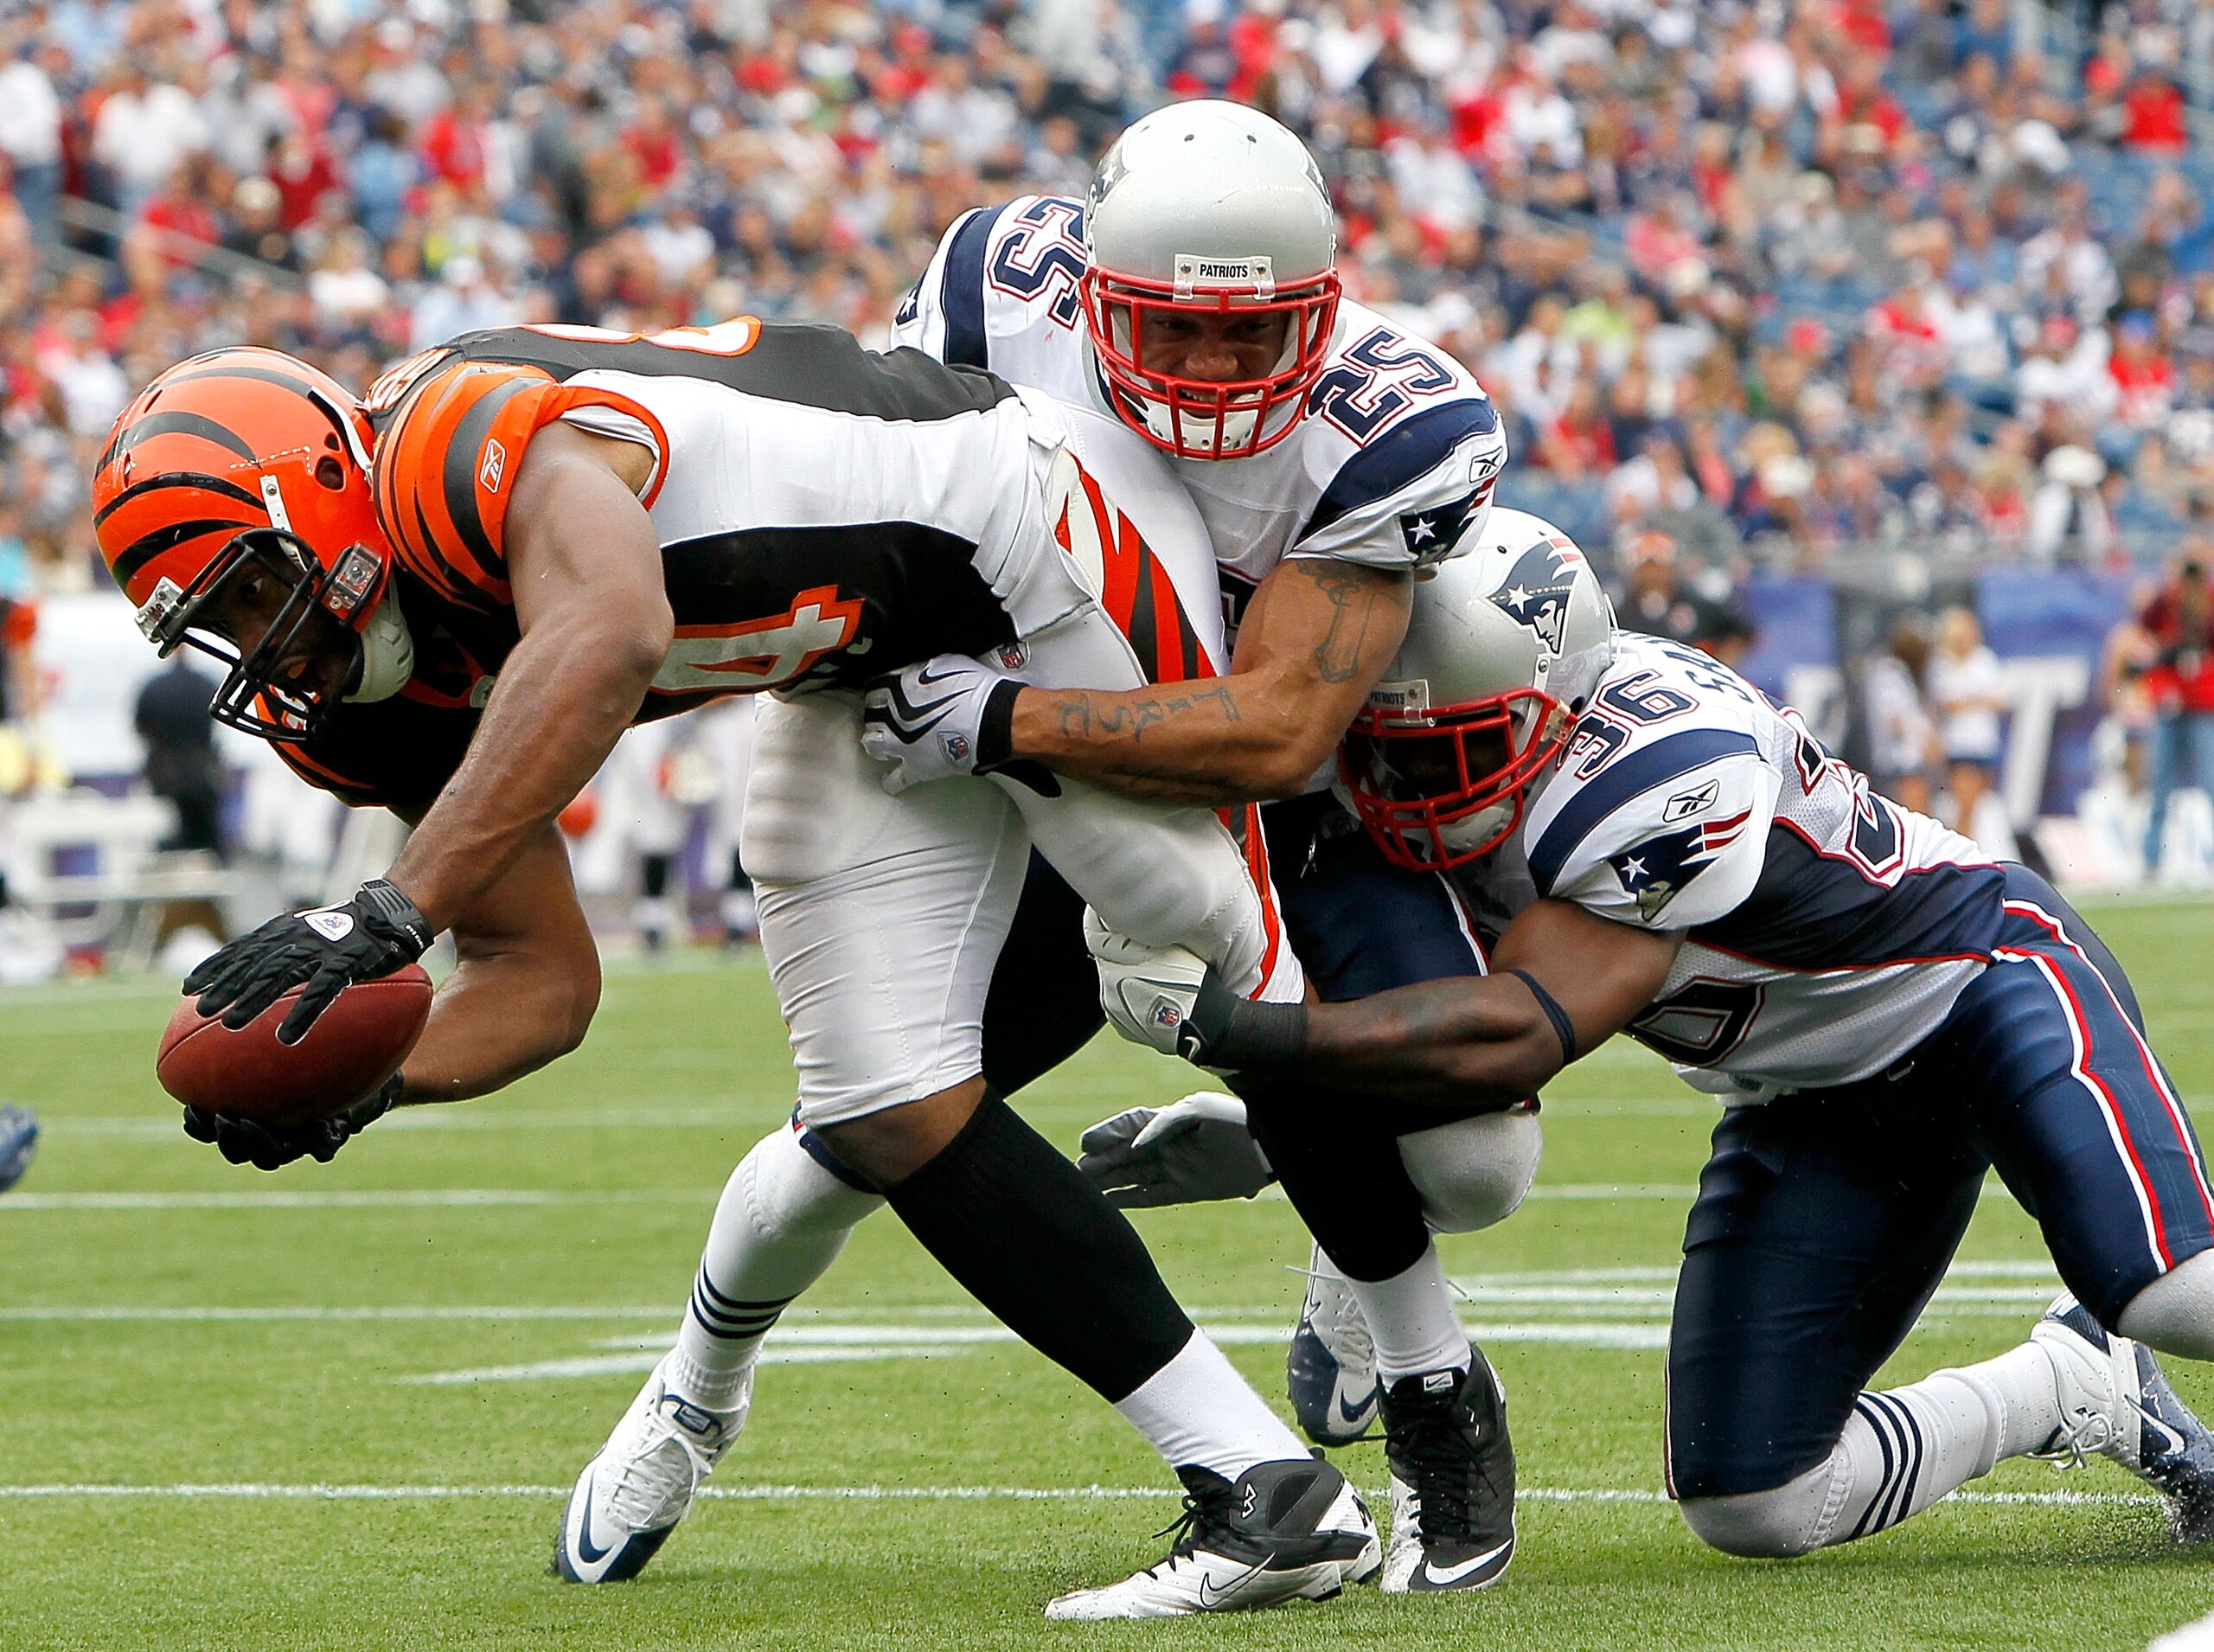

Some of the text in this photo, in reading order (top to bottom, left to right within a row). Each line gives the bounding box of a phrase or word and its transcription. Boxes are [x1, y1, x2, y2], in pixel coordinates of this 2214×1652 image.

[1199, 264, 1248, 278] PATRIOTS
[1305, 325, 1459, 449] 25
[1555, 669, 1700, 781] 36
